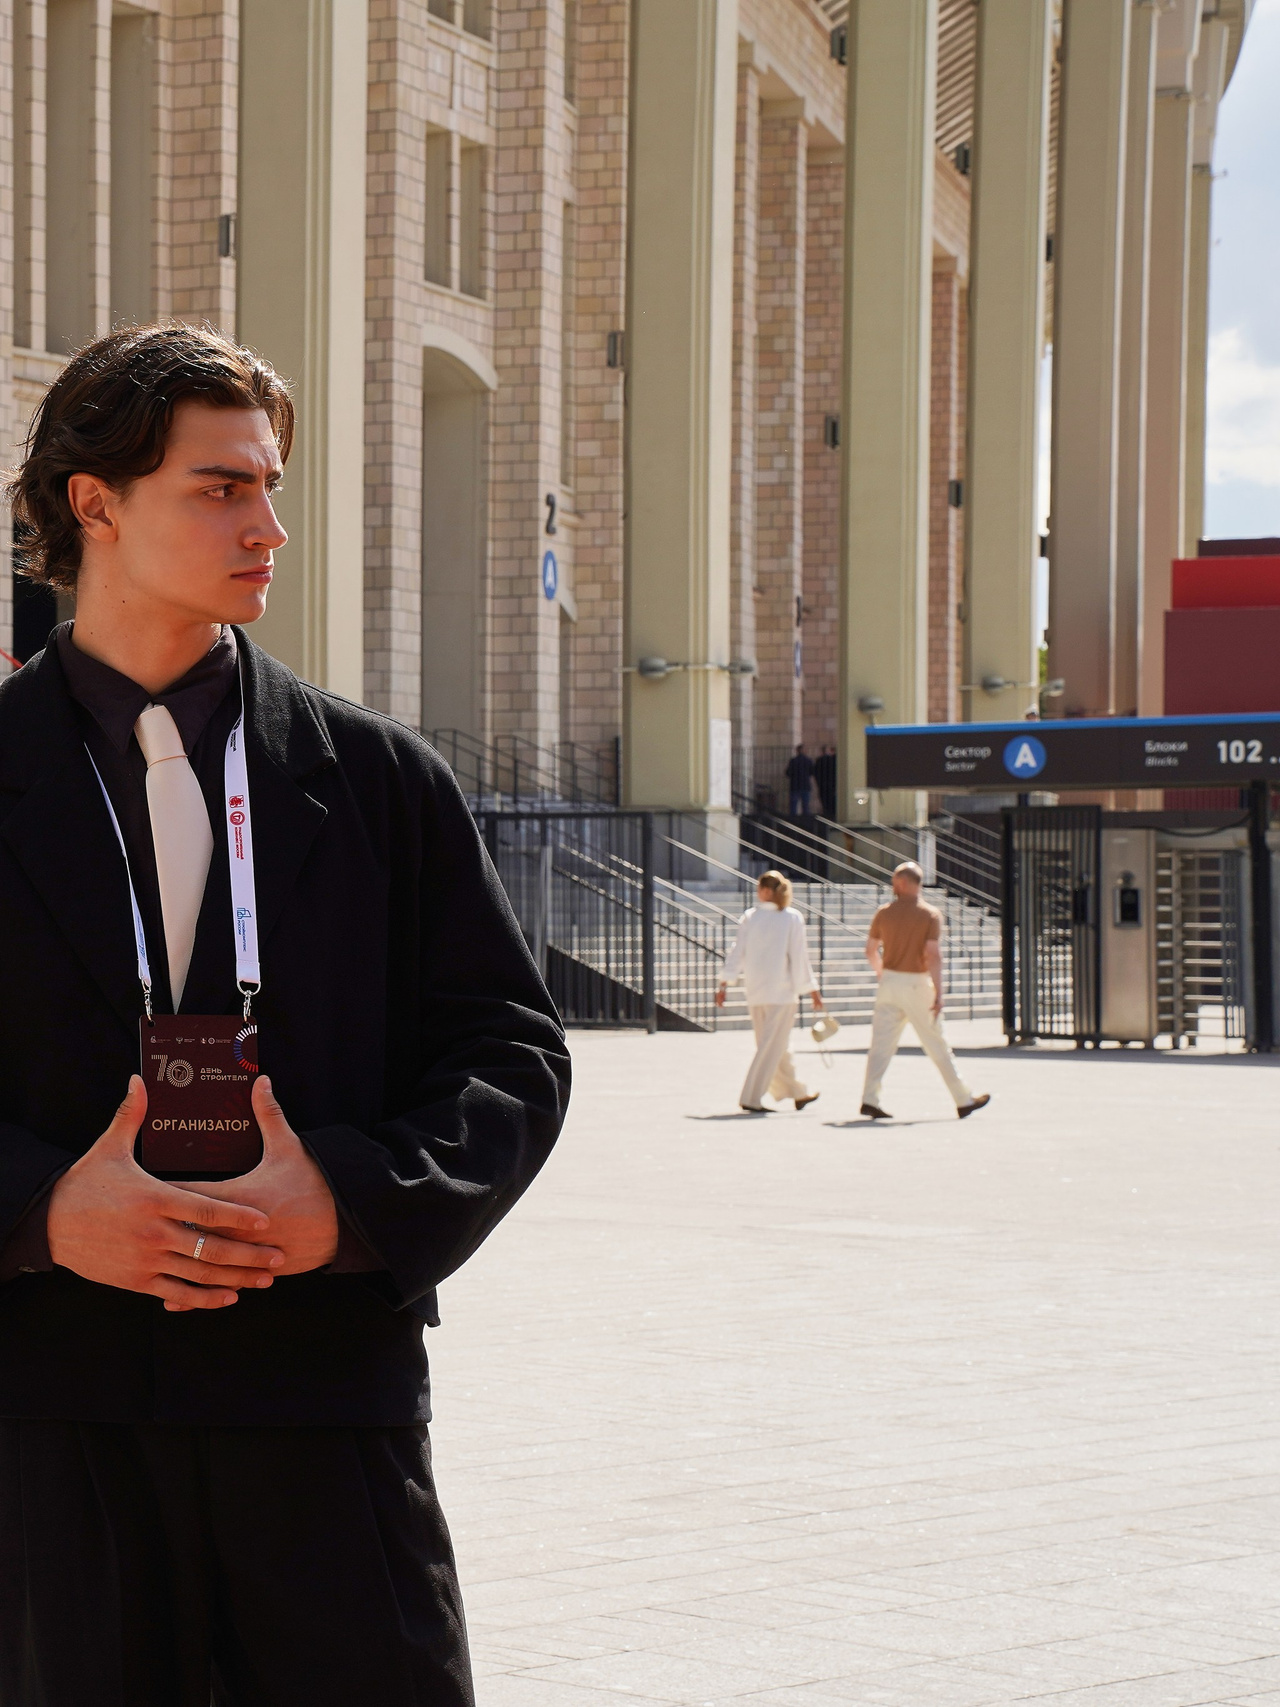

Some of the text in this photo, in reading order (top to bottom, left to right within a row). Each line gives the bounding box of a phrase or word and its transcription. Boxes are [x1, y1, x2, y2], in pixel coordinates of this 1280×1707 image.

[545, 493, 556, 535] 2
[944, 745, 992, 760] Сектор
[1145, 739, 1189, 754] Блоки
[1216, 739, 1263, 764] 102
[1013, 742, 1038, 769] A
[944, 761, 977, 773] Sector
[200, 1074, 248, 1082] СТРОИТЕЛЯ
[151, 1118, 250, 1132] ОРГАНИЗАТОР
